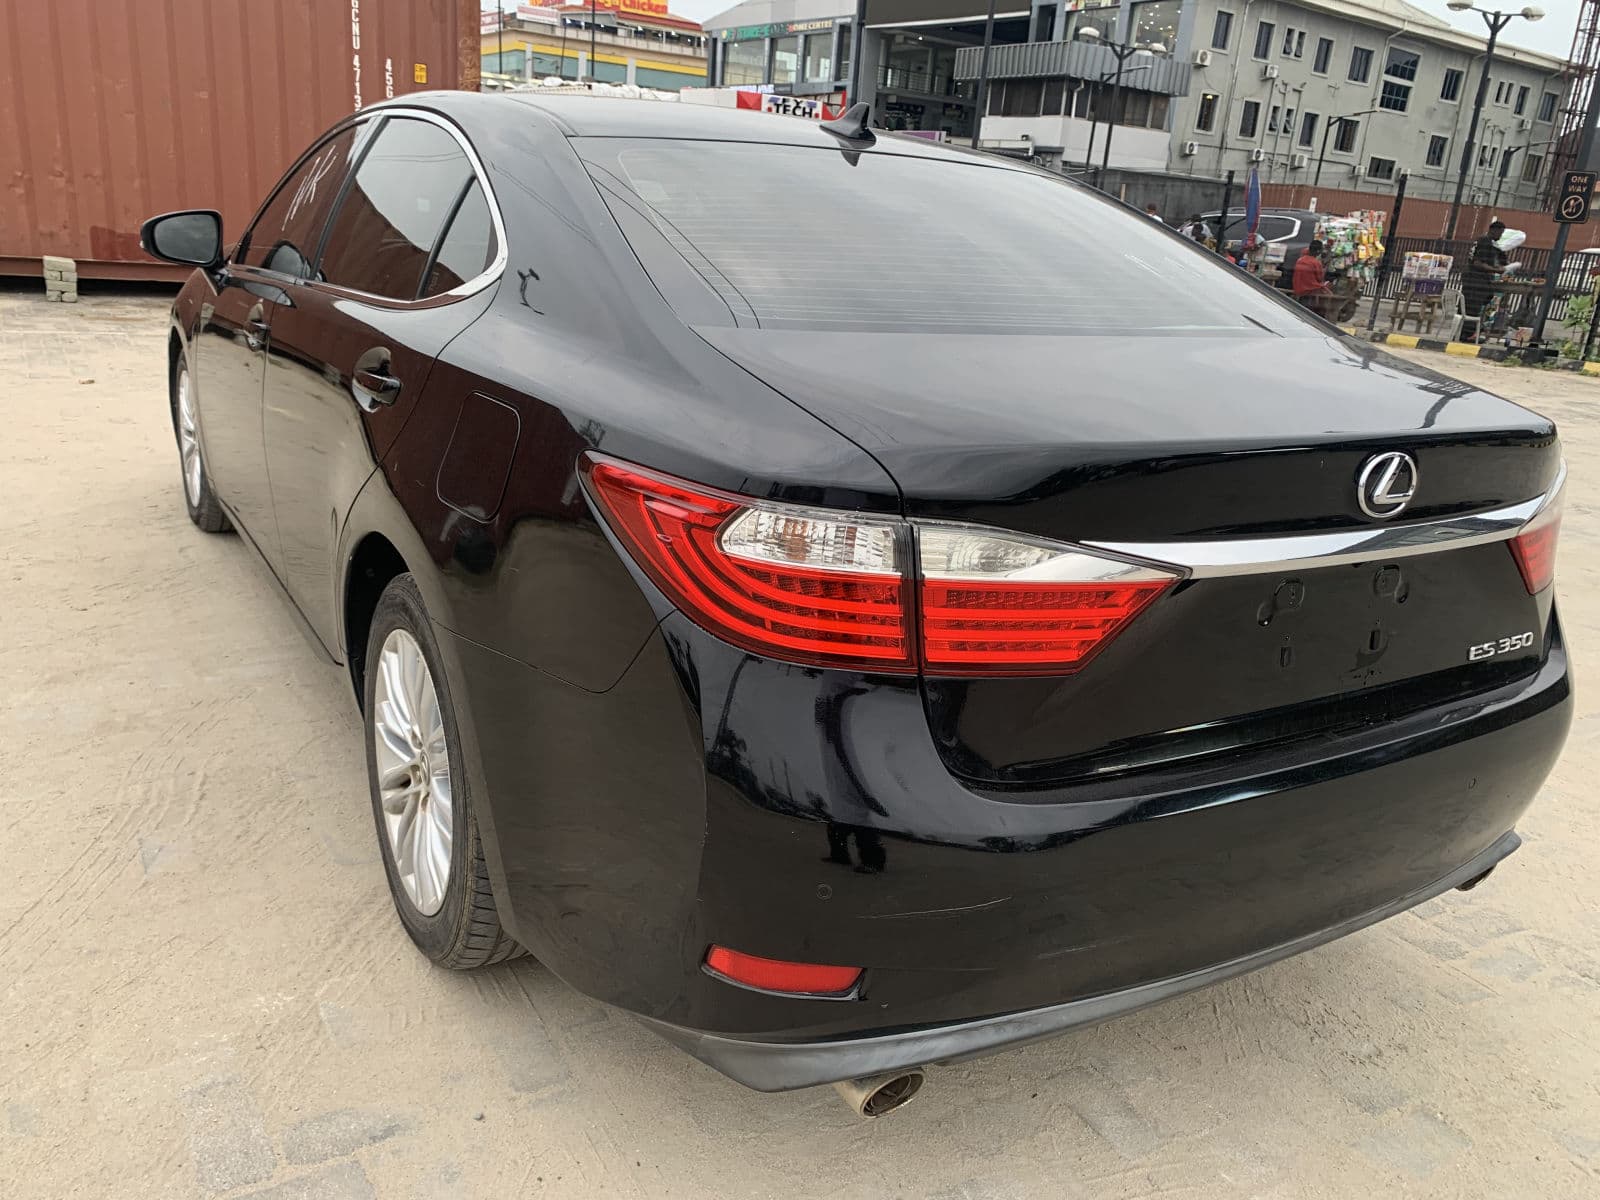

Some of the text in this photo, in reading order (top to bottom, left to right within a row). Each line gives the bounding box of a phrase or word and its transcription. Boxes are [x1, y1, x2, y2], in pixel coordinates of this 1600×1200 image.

[353, 54, 362, 112] 4713
[773, 102, 813, 119] TECH
[1571, 175, 1588, 183] ONE
[1568, 184, 1587, 193] WAY
[1468, 631, 1534, 661] ES 350
